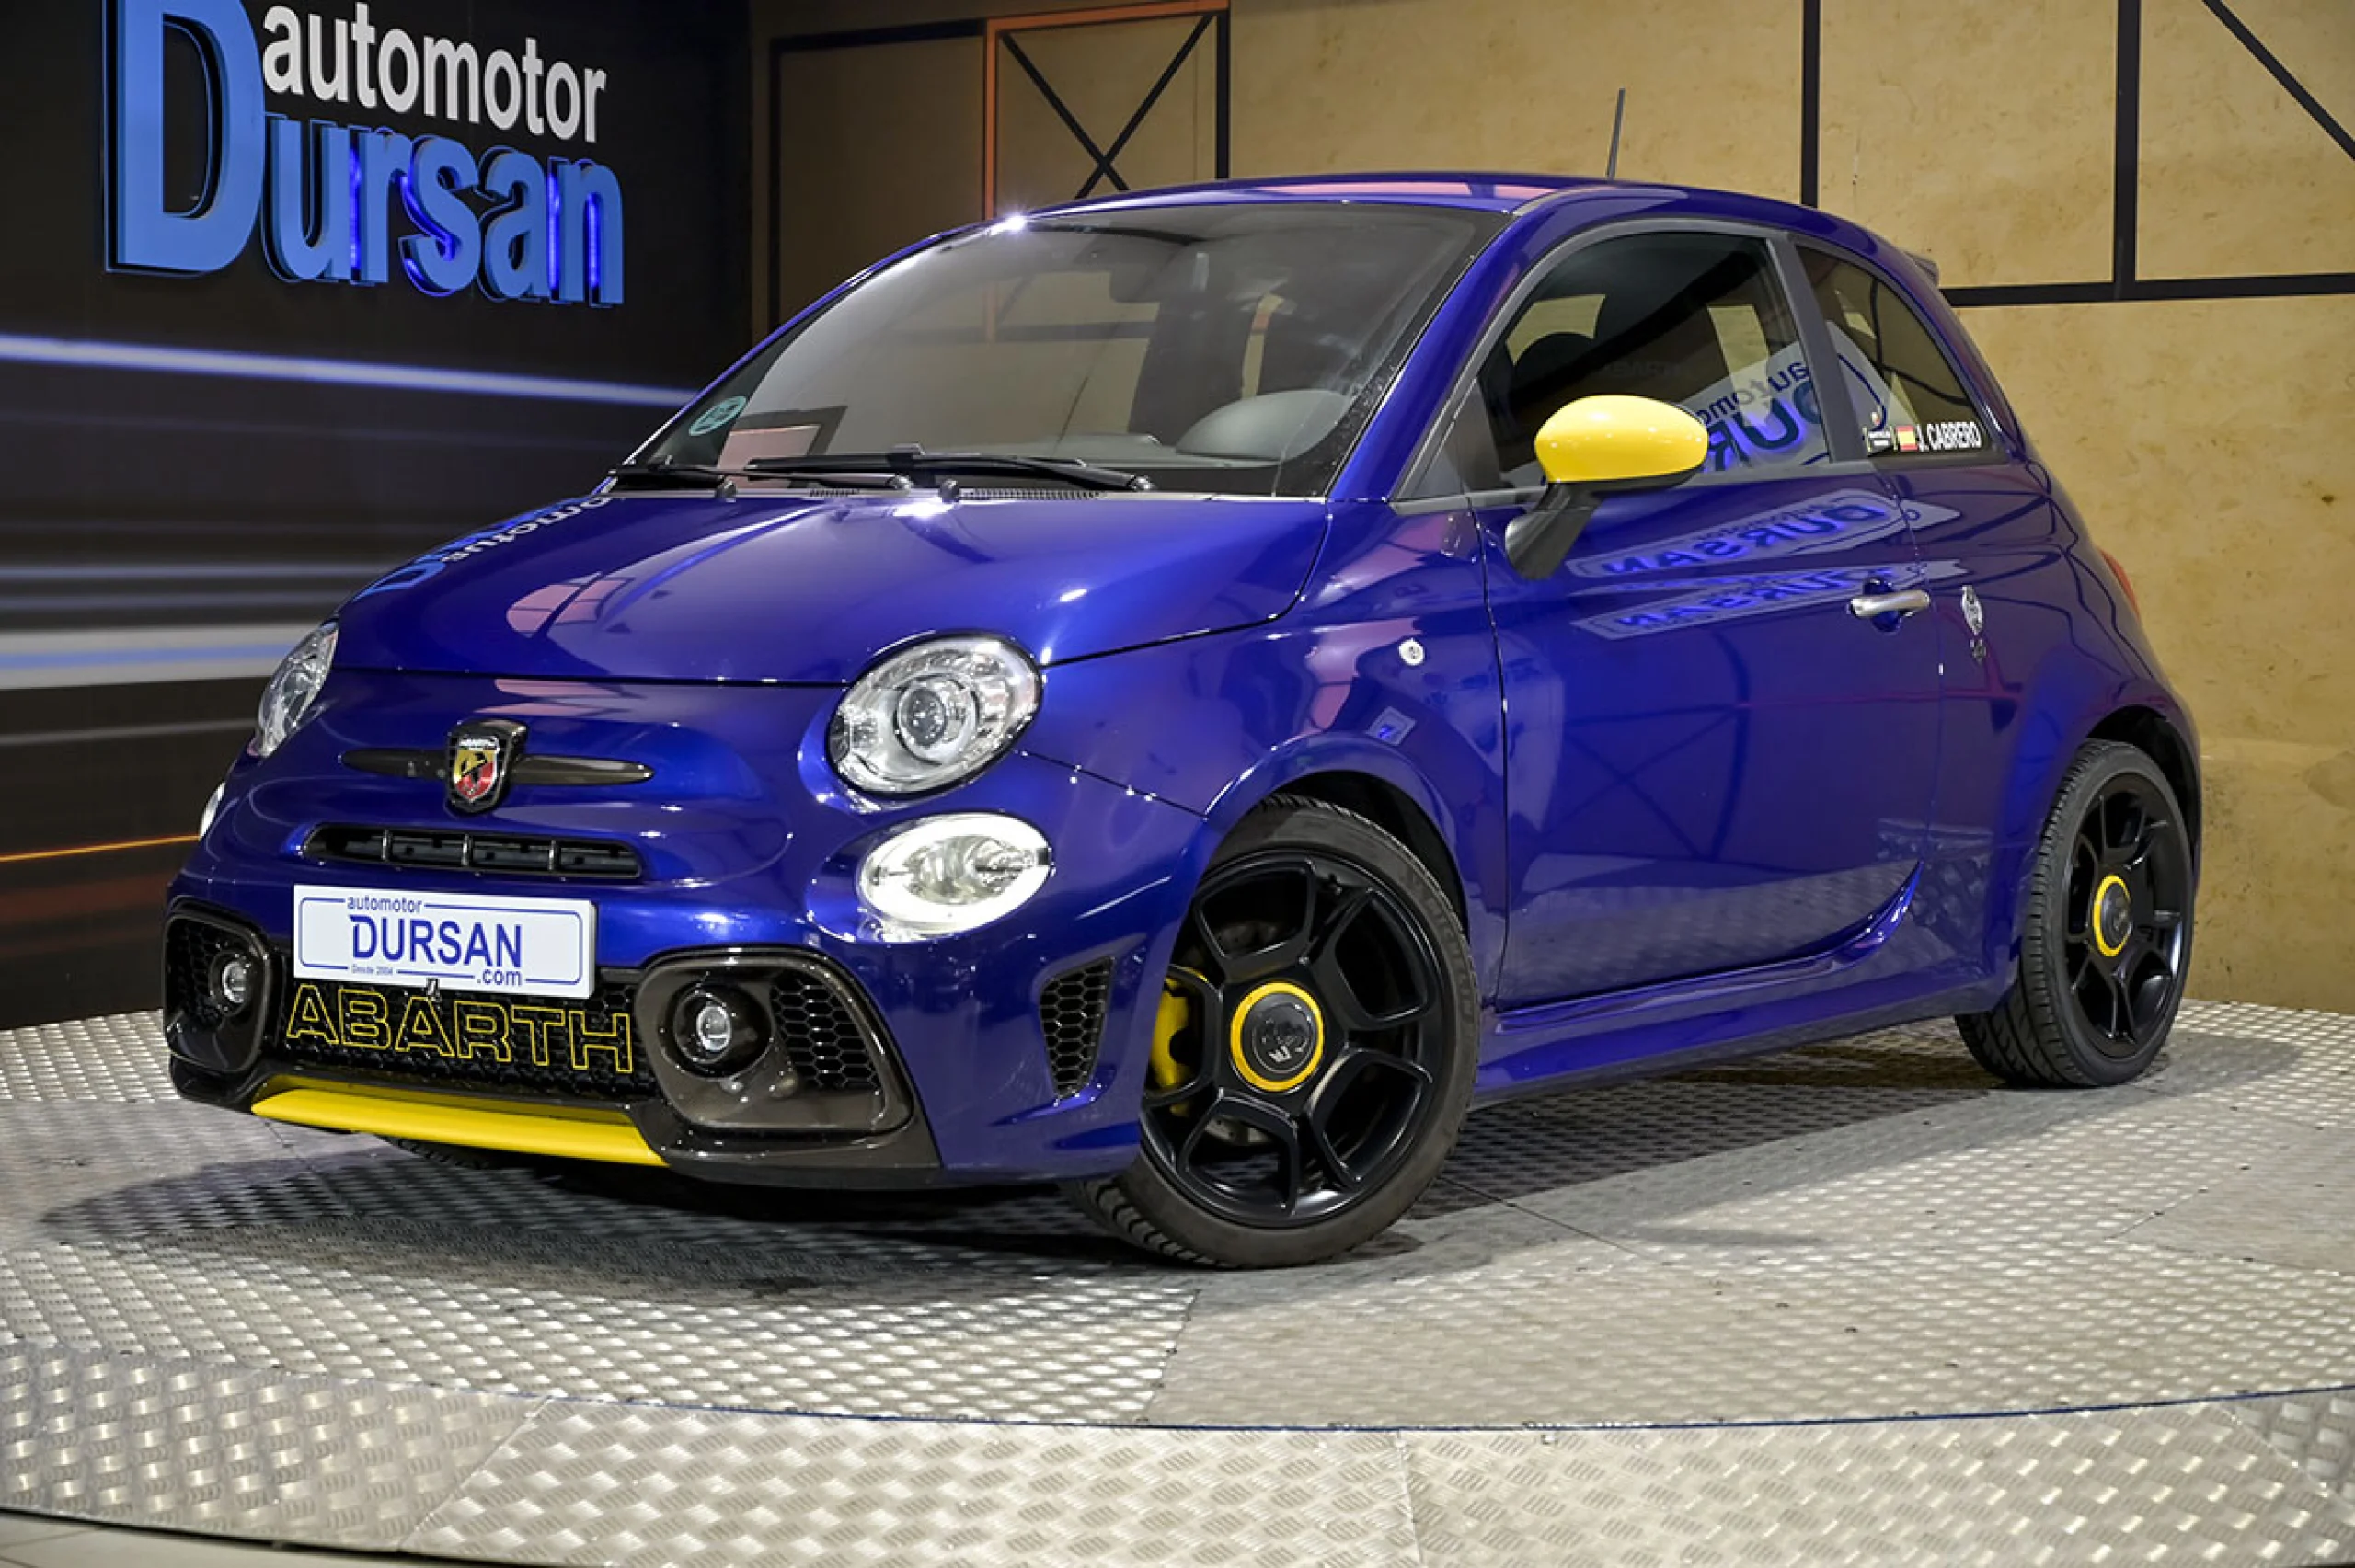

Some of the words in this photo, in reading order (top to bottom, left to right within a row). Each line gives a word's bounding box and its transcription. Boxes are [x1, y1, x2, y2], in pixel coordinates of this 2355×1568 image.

[263, 2, 607, 143] automotor
[107, 0, 625, 307] Dursan
[1926, 420, 1981, 451] CABRERO
[347, 895, 423, 914] automotor
[349, 913, 522, 968] DURSAN
[477, 968, 523, 987] .com
[286, 983, 634, 1074] ABARTH
